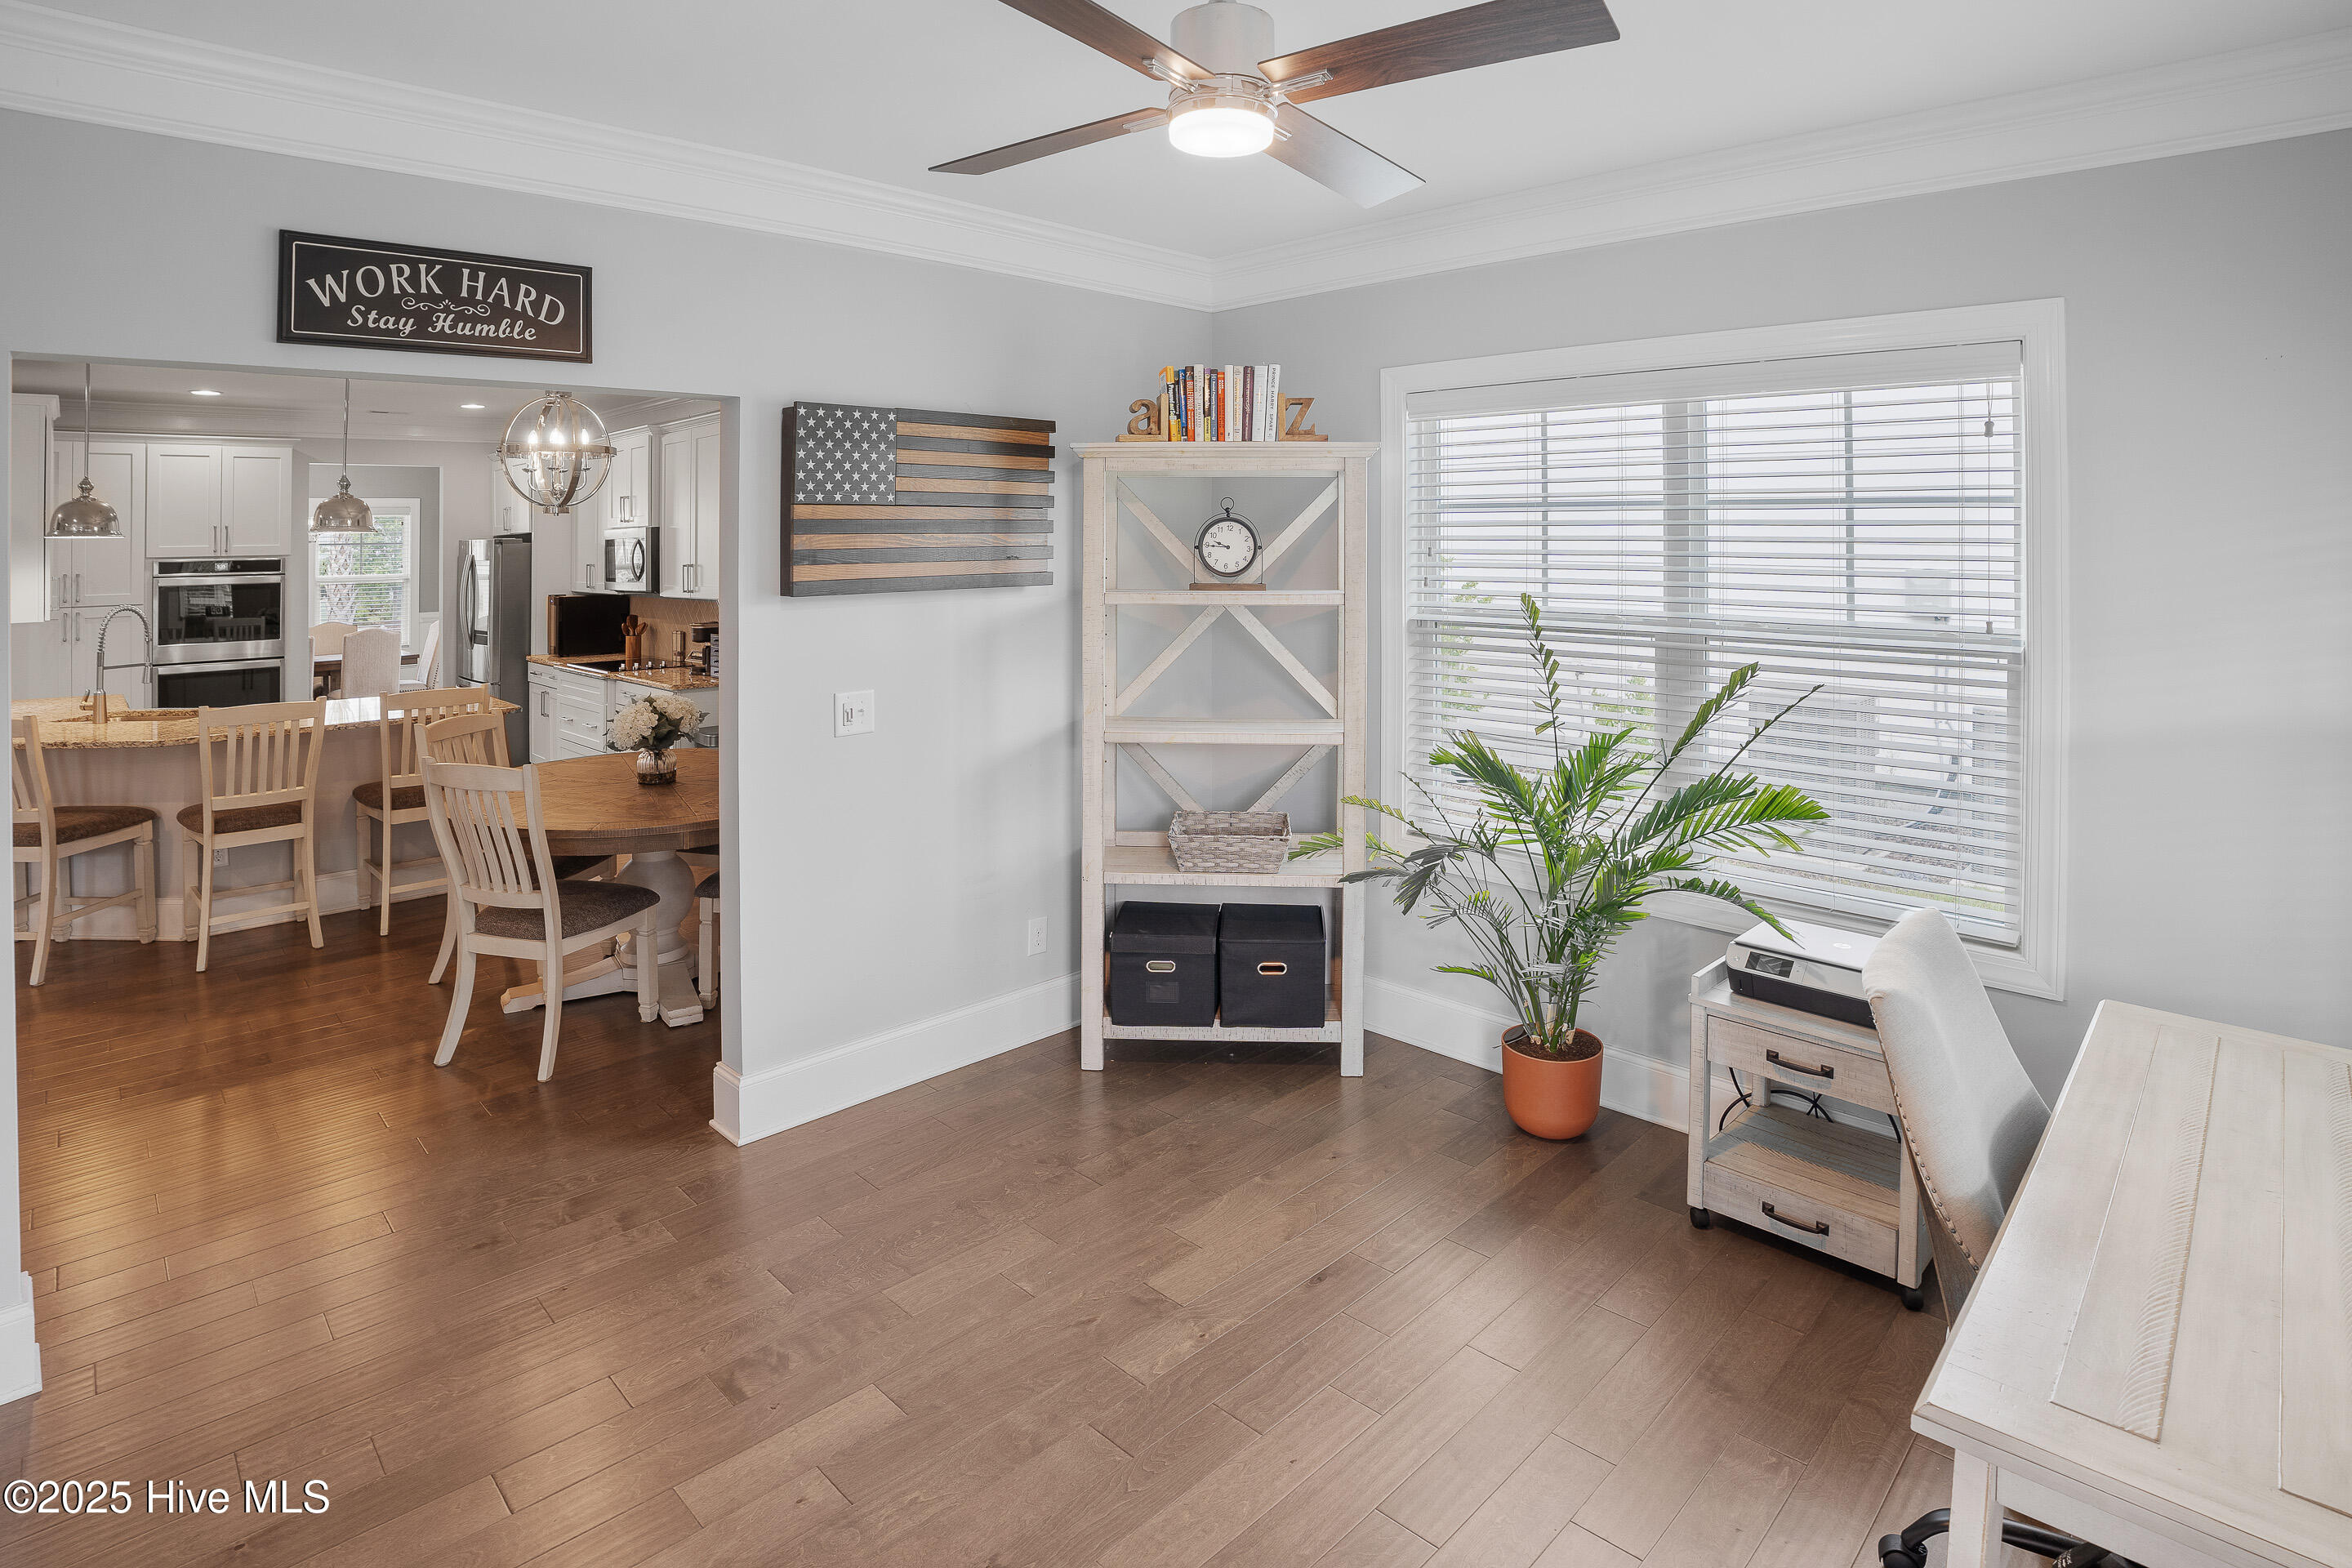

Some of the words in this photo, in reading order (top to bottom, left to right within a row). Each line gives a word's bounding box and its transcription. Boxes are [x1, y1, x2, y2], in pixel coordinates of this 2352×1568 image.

[305, 264, 443, 307] WORK
[460, 268, 565, 325] HARD
[346, 305, 417, 336] Stay
[427, 312, 537, 340] Humble
[1127, 399, 1160, 434] a
